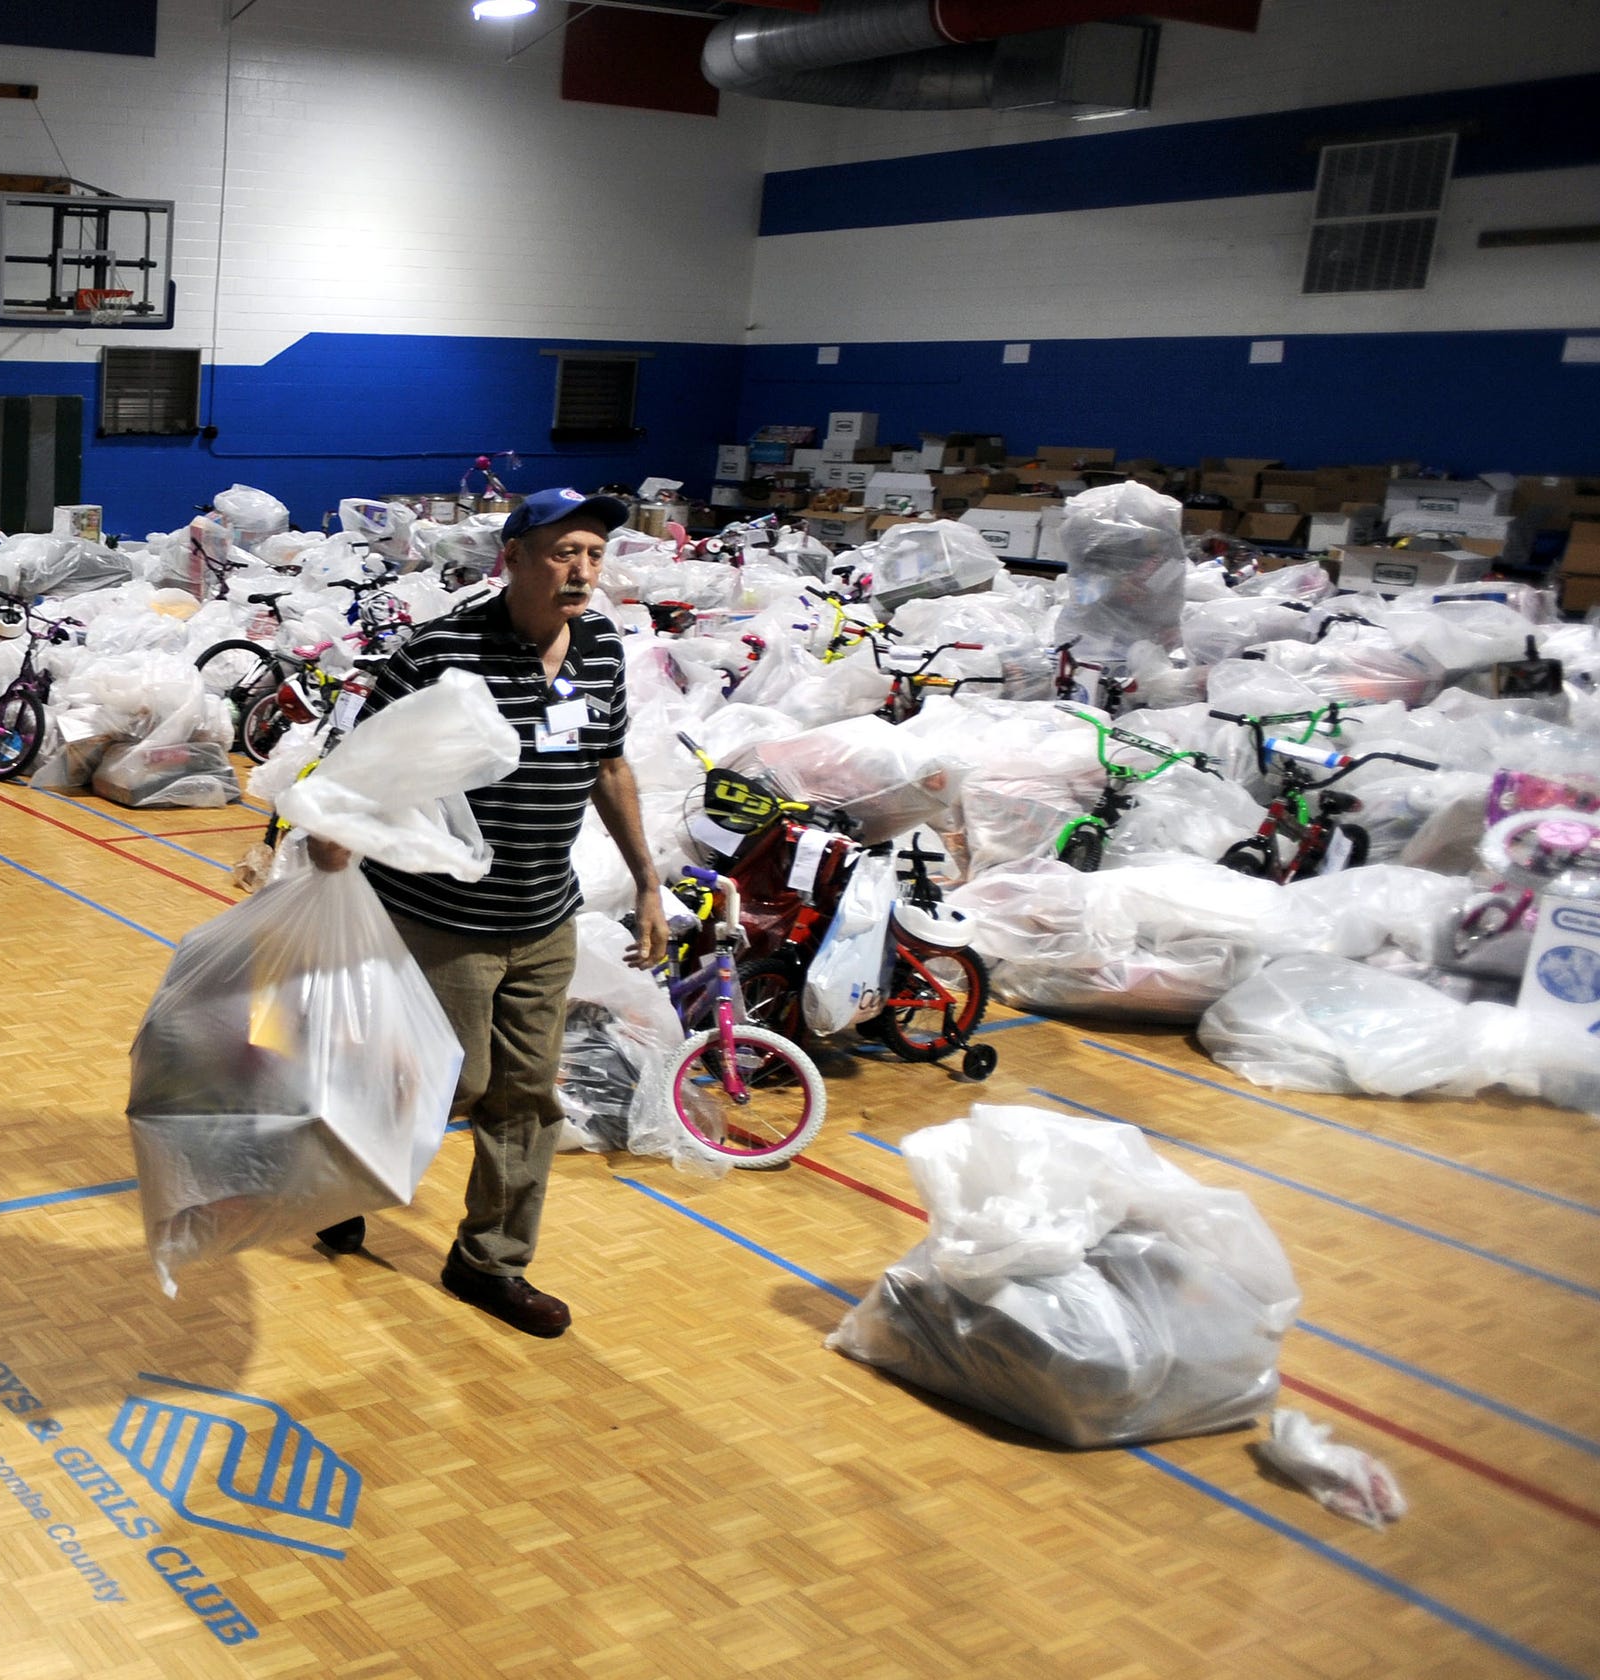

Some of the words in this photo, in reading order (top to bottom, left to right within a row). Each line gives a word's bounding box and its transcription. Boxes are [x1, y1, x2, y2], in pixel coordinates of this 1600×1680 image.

[26, 1418, 64, 1444] &
[53, 1446, 163, 1540] GIRLS
[146, 1545, 260, 1646] CLUB
[47, 1523, 127, 1603] County
